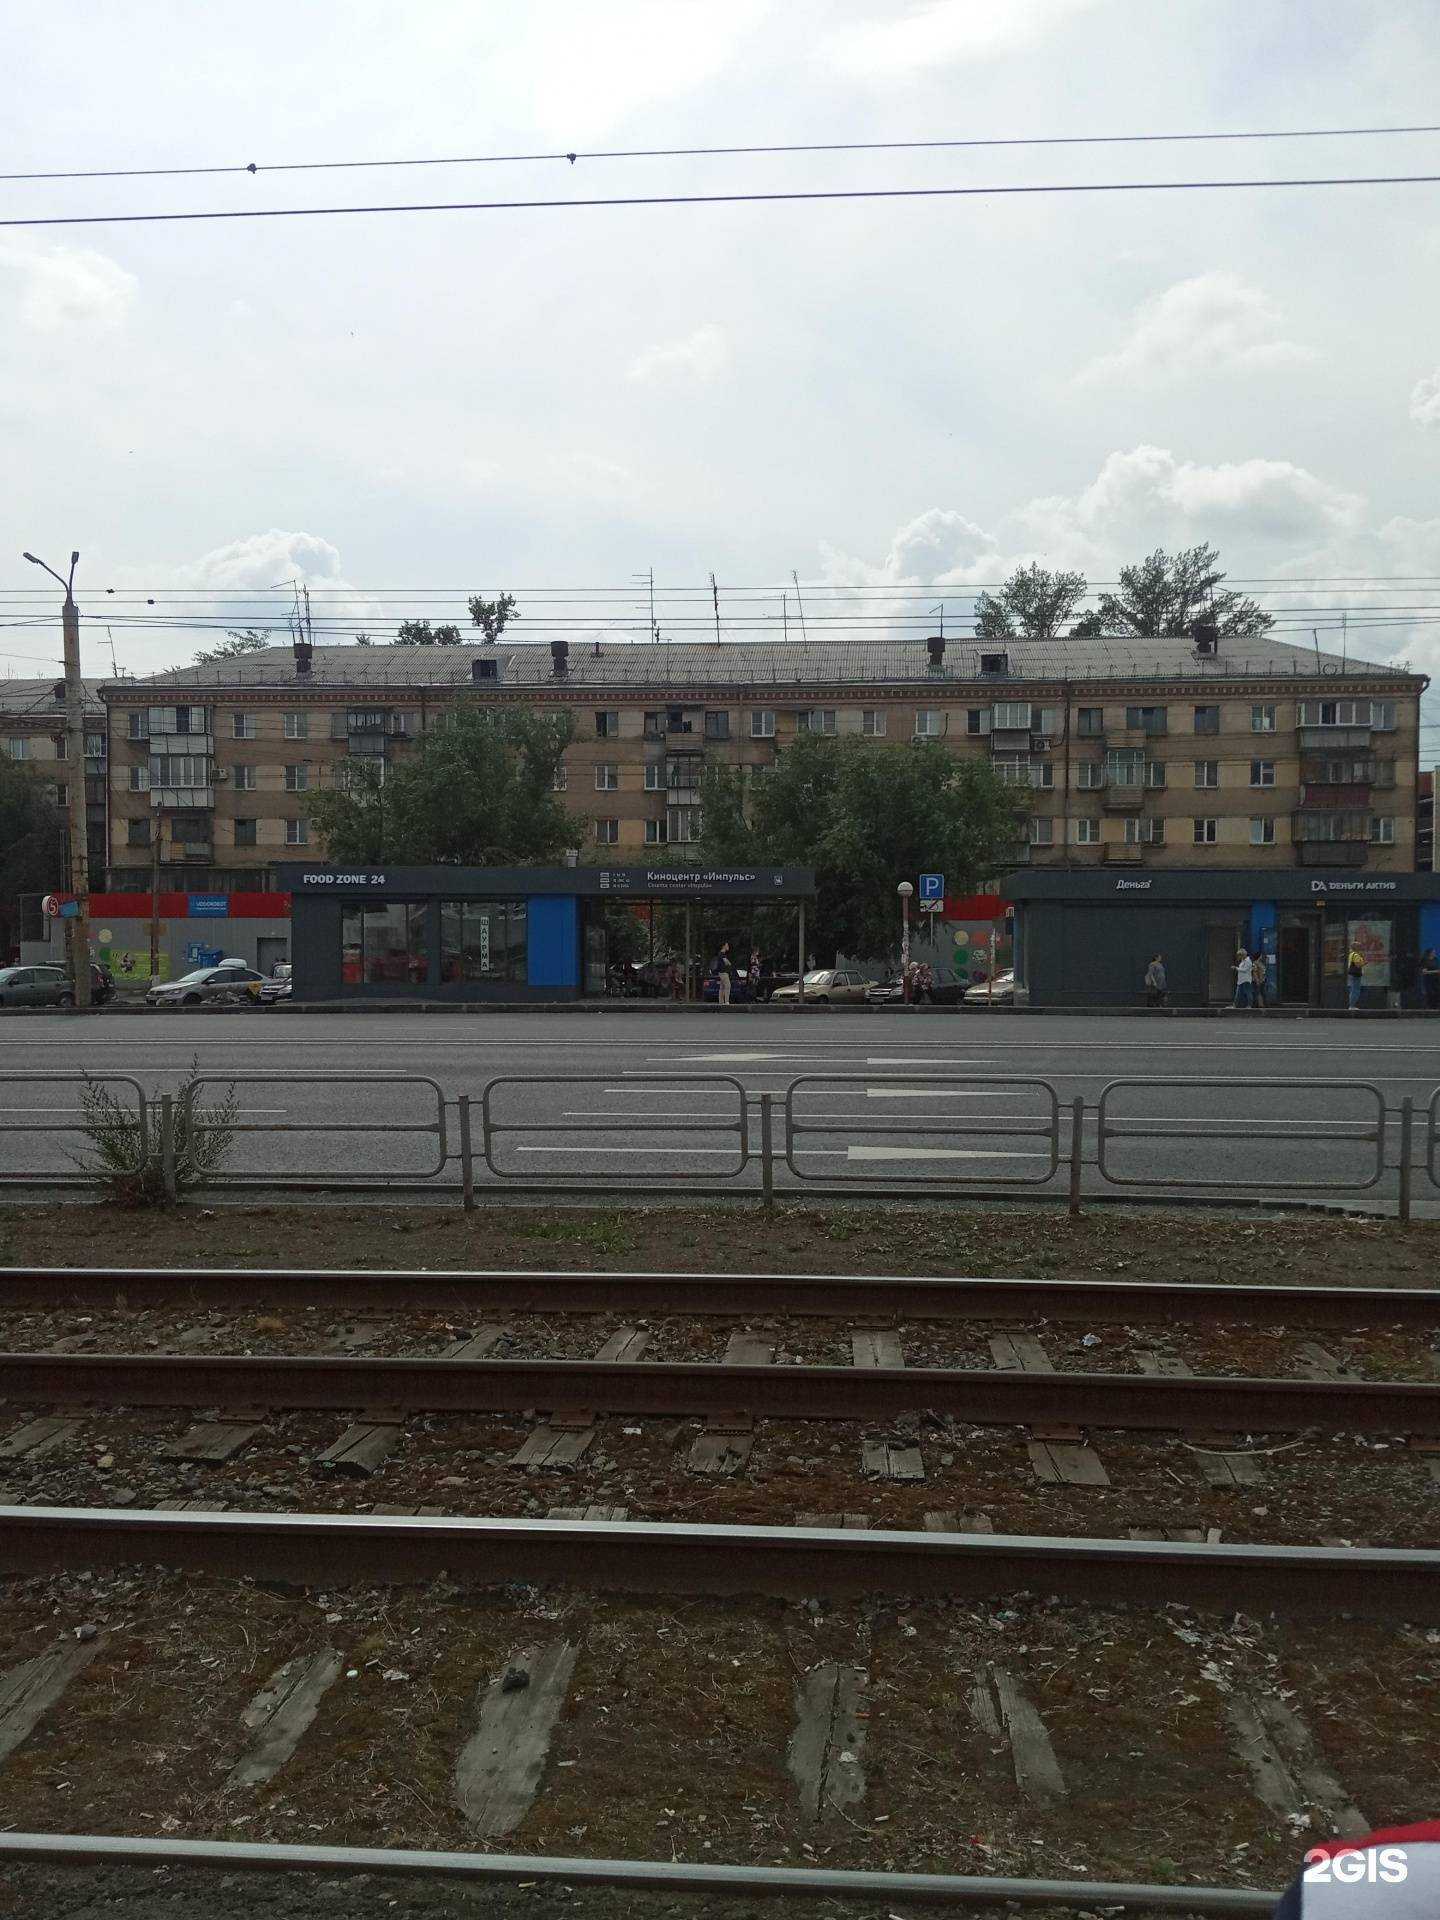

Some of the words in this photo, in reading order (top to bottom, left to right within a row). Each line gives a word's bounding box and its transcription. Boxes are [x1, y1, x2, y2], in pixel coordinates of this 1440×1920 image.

[303, 874, 334, 884] FOOD
[336, 874, 367, 884] ZONE
[371, 874, 386, 884] 24
[647, 872, 700, 882] Киноцентр
[703, 872, 755, 882] «Импульс»
[926, 877, 939, 896] P
[481, 918, 489, 968] ШАУРМА
